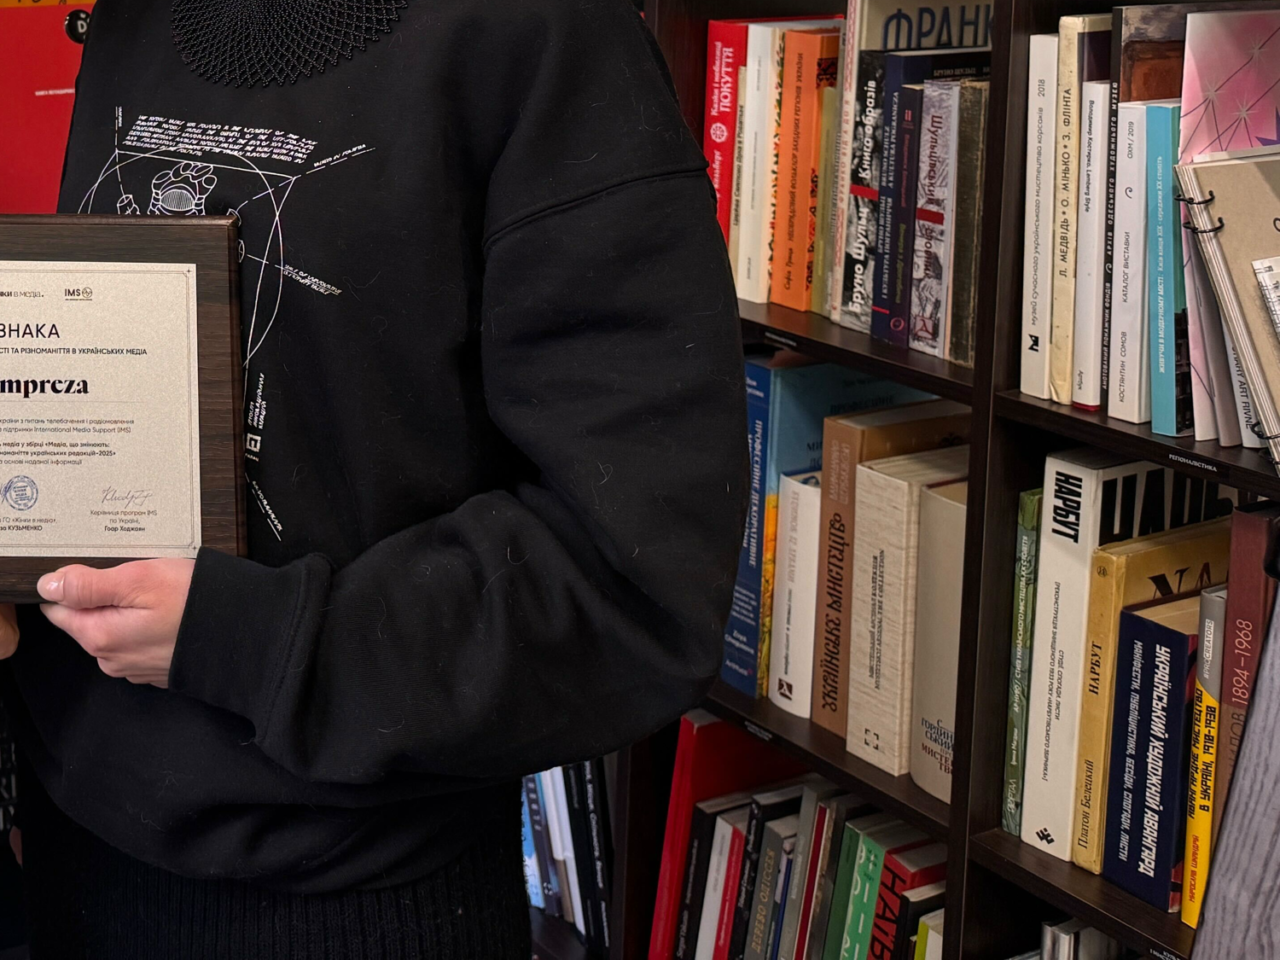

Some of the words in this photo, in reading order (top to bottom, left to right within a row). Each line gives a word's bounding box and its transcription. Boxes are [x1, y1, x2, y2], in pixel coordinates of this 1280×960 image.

[719, 47, 734, 112] ПОКУТТЯ
[1037, 79, 1046, 97] 2018
[1063, 88, 1072, 128] ФЛІНТА
[1061, 151, 1071, 192] МІНЬКО
[852, 207, 871, 258] Шульц
[1060, 218, 1070, 263] МЕДВІДЬ
[64, 289, 81, 297] IMS
[849, 260, 865, 314] Бруно
[20, 347, 71, 355] РІЗНОМАНІТТЯ
[78, 347, 125, 355] УКРАЇНСЬКИХ
[1238, 380, 1249, 400] ART
[1241, 401, 1253, 429] RIVNE
[1051, 470, 1083, 544] НАРБУТ
[1088, 641, 1103, 696] НАРБУТ
[1149, 644, 1172, 739] УКРАЇНСЬКИЙ
[1192, 688, 1204, 755] МИСТЕЦТВО
[1080, 758, 1094, 804] Белецкий
[1144, 739, 1166, 814] ХУДОЖНІЙ
[1188, 756, 1201, 820] АВАНГАРДНЕ
[1076, 807, 1091, 850] Платон
[1138, 814, 1160, 878] АВАНГАРД
